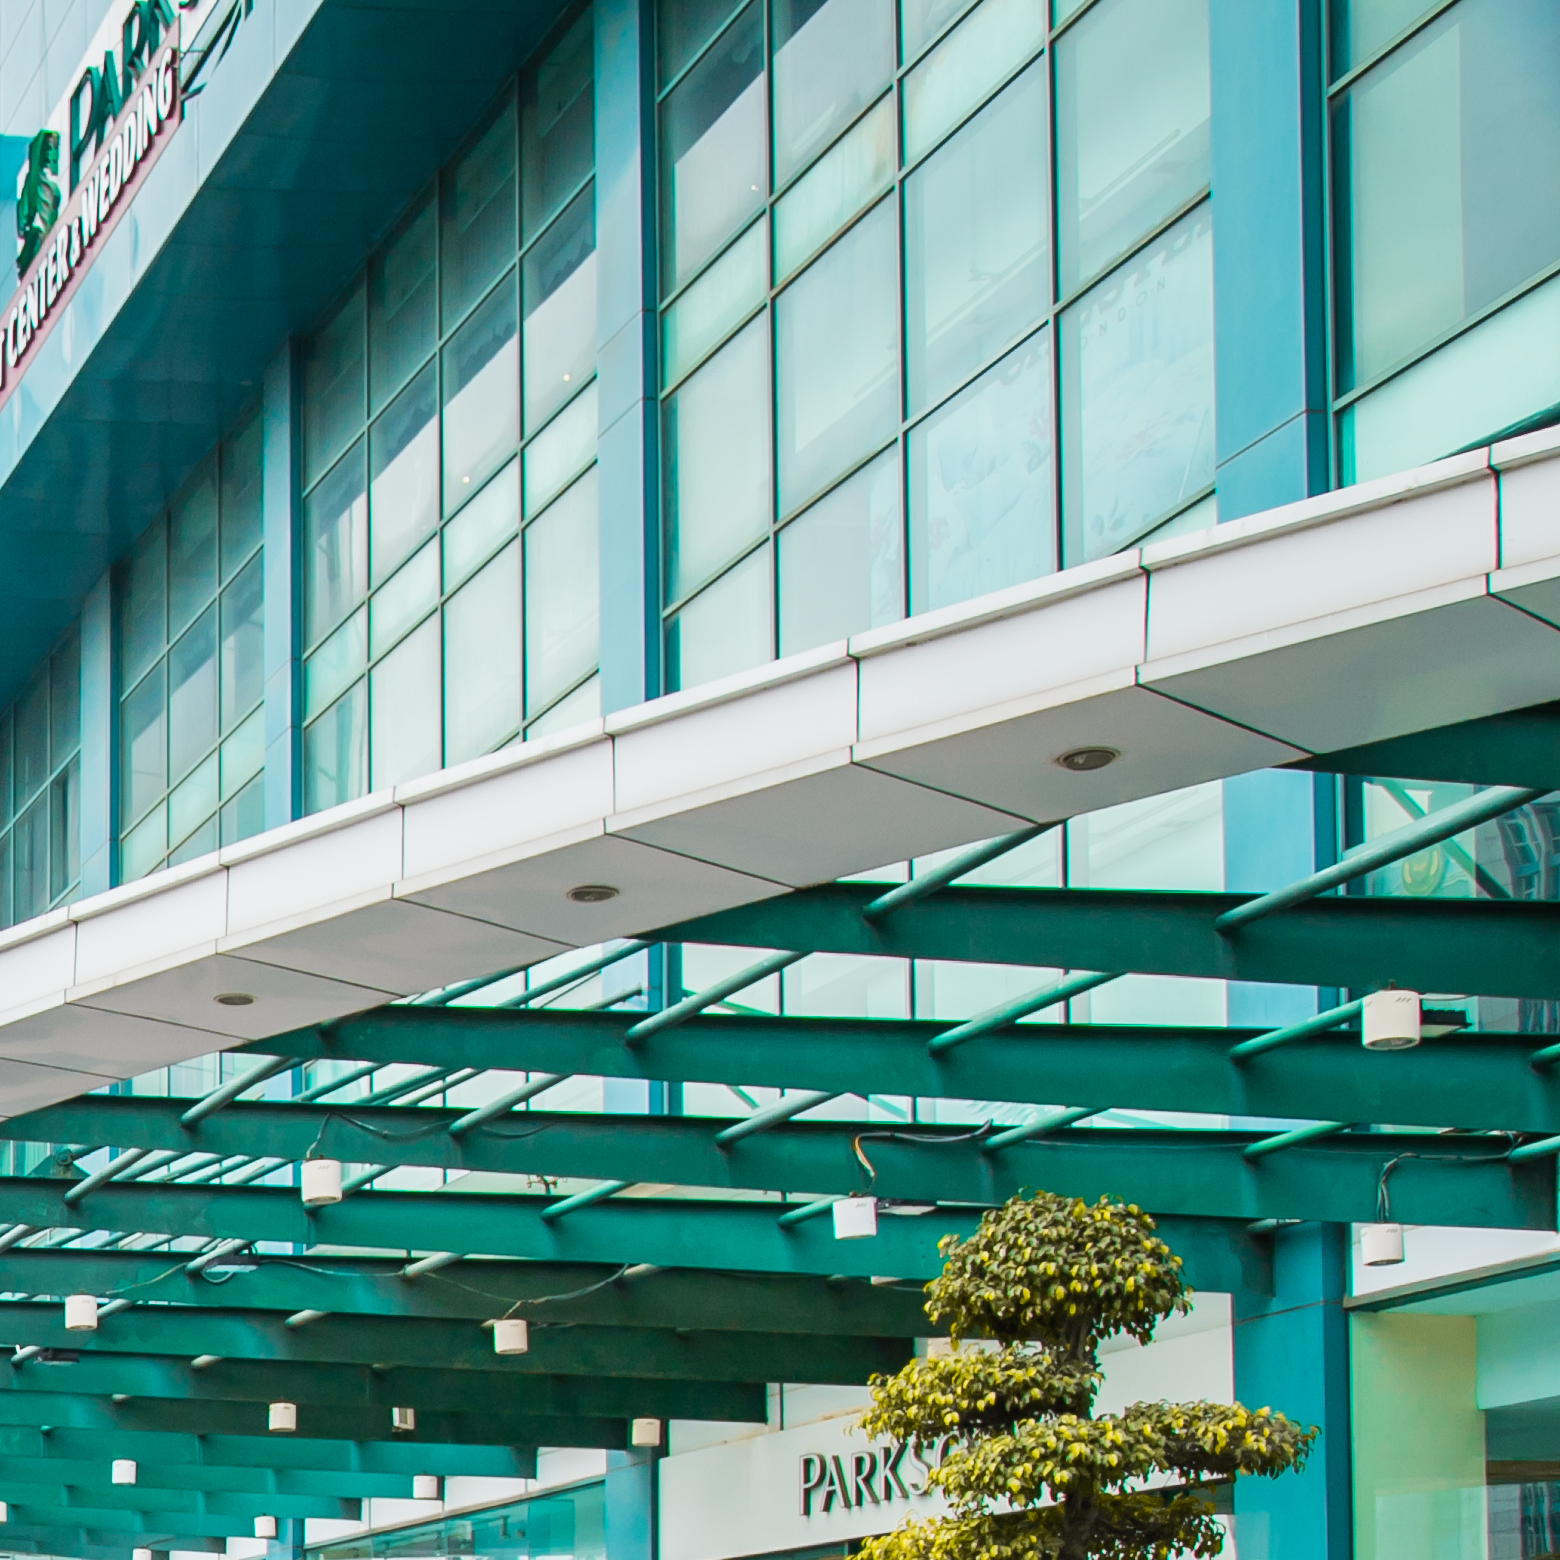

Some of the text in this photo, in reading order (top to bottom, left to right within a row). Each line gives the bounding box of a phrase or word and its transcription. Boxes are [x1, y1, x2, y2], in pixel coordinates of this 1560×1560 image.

[6, 224, 70, 368] CENTER
[80, 47, 174, 248] WEDDING
[799, 1434, 961, 1516] PARKS
